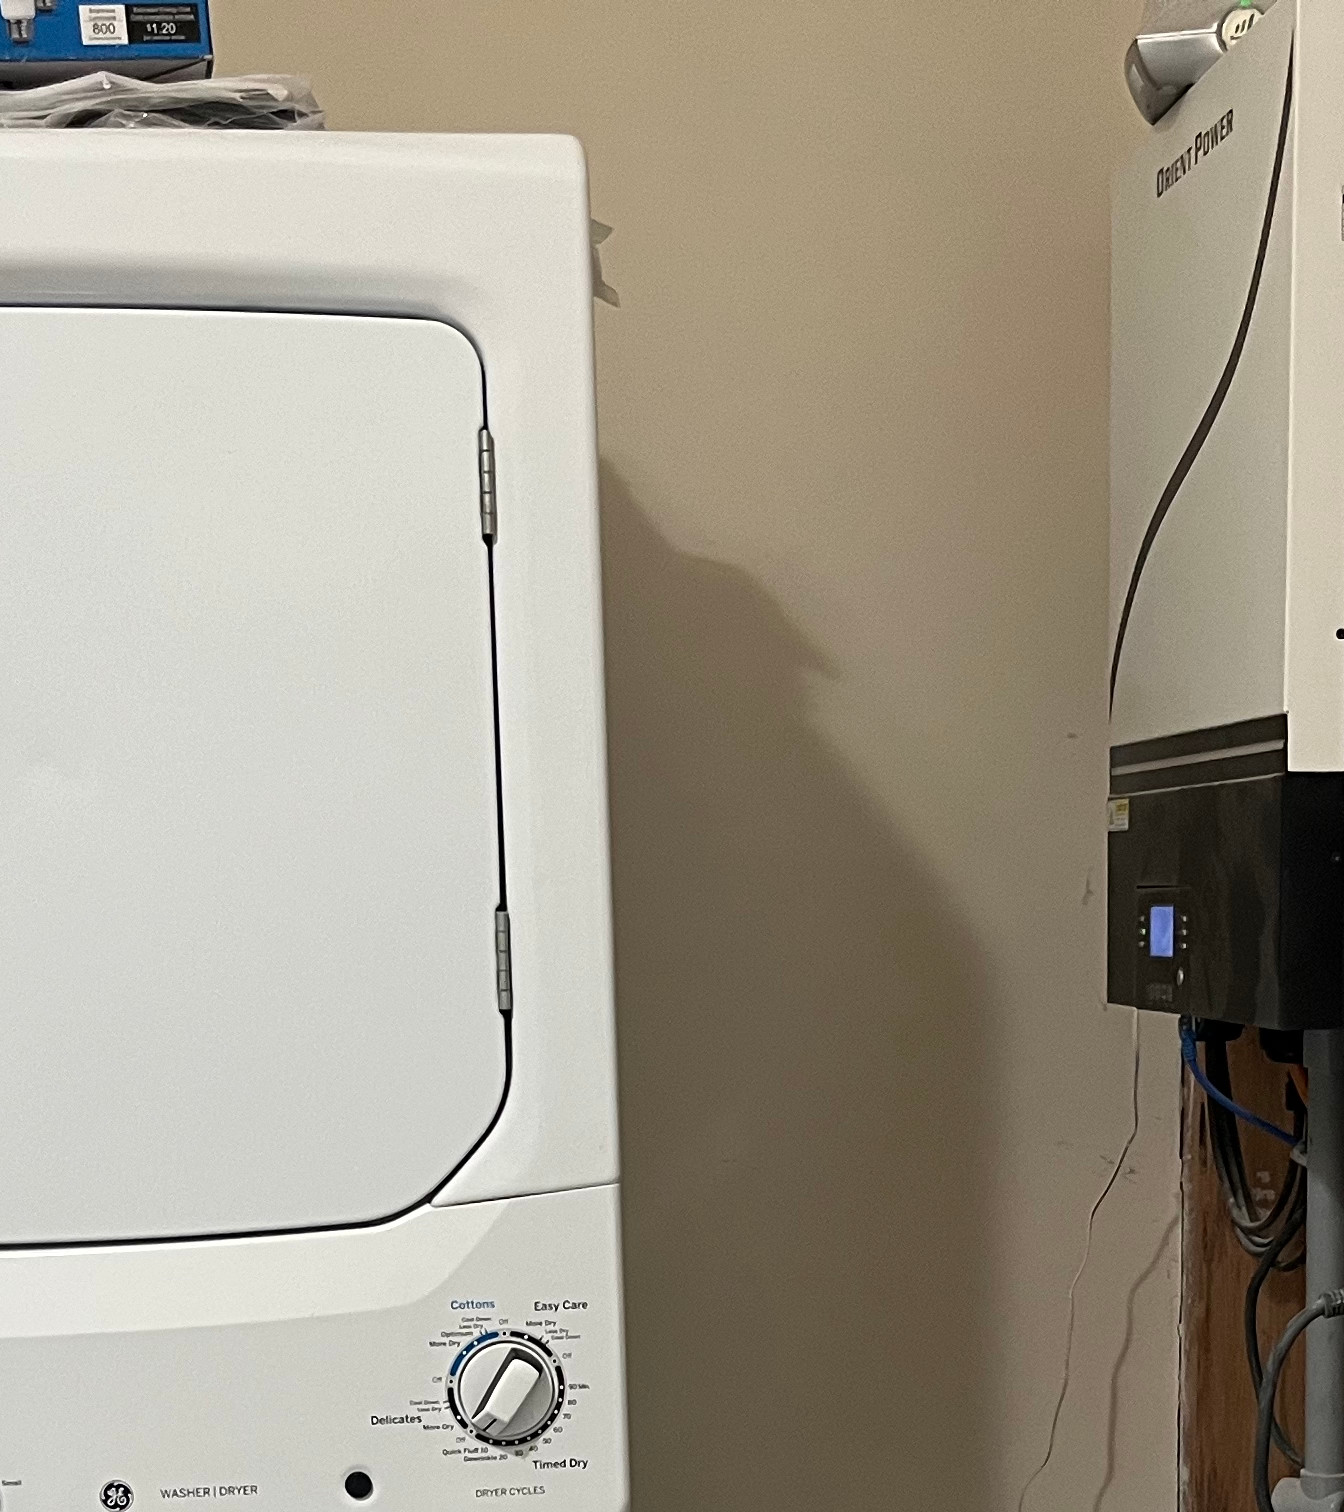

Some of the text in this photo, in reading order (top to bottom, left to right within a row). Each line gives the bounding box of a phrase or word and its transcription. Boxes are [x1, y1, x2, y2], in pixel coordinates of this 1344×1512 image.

[92, 22, 116, 35] 800
[1156, 108, 1234, 198] ORIENT POWER
[450, 1300, 496, 1310] Cottons
[534, 1299, 588, 1312] Easy Care
[370, 1414, 423, 1425] Delicates
[532, 1458, 589, 1470] Timed Dry
[160, 1485, 258, 1499] WASHER DRYER
[475, 1486, 545, 1498] DRYER CYCLES
